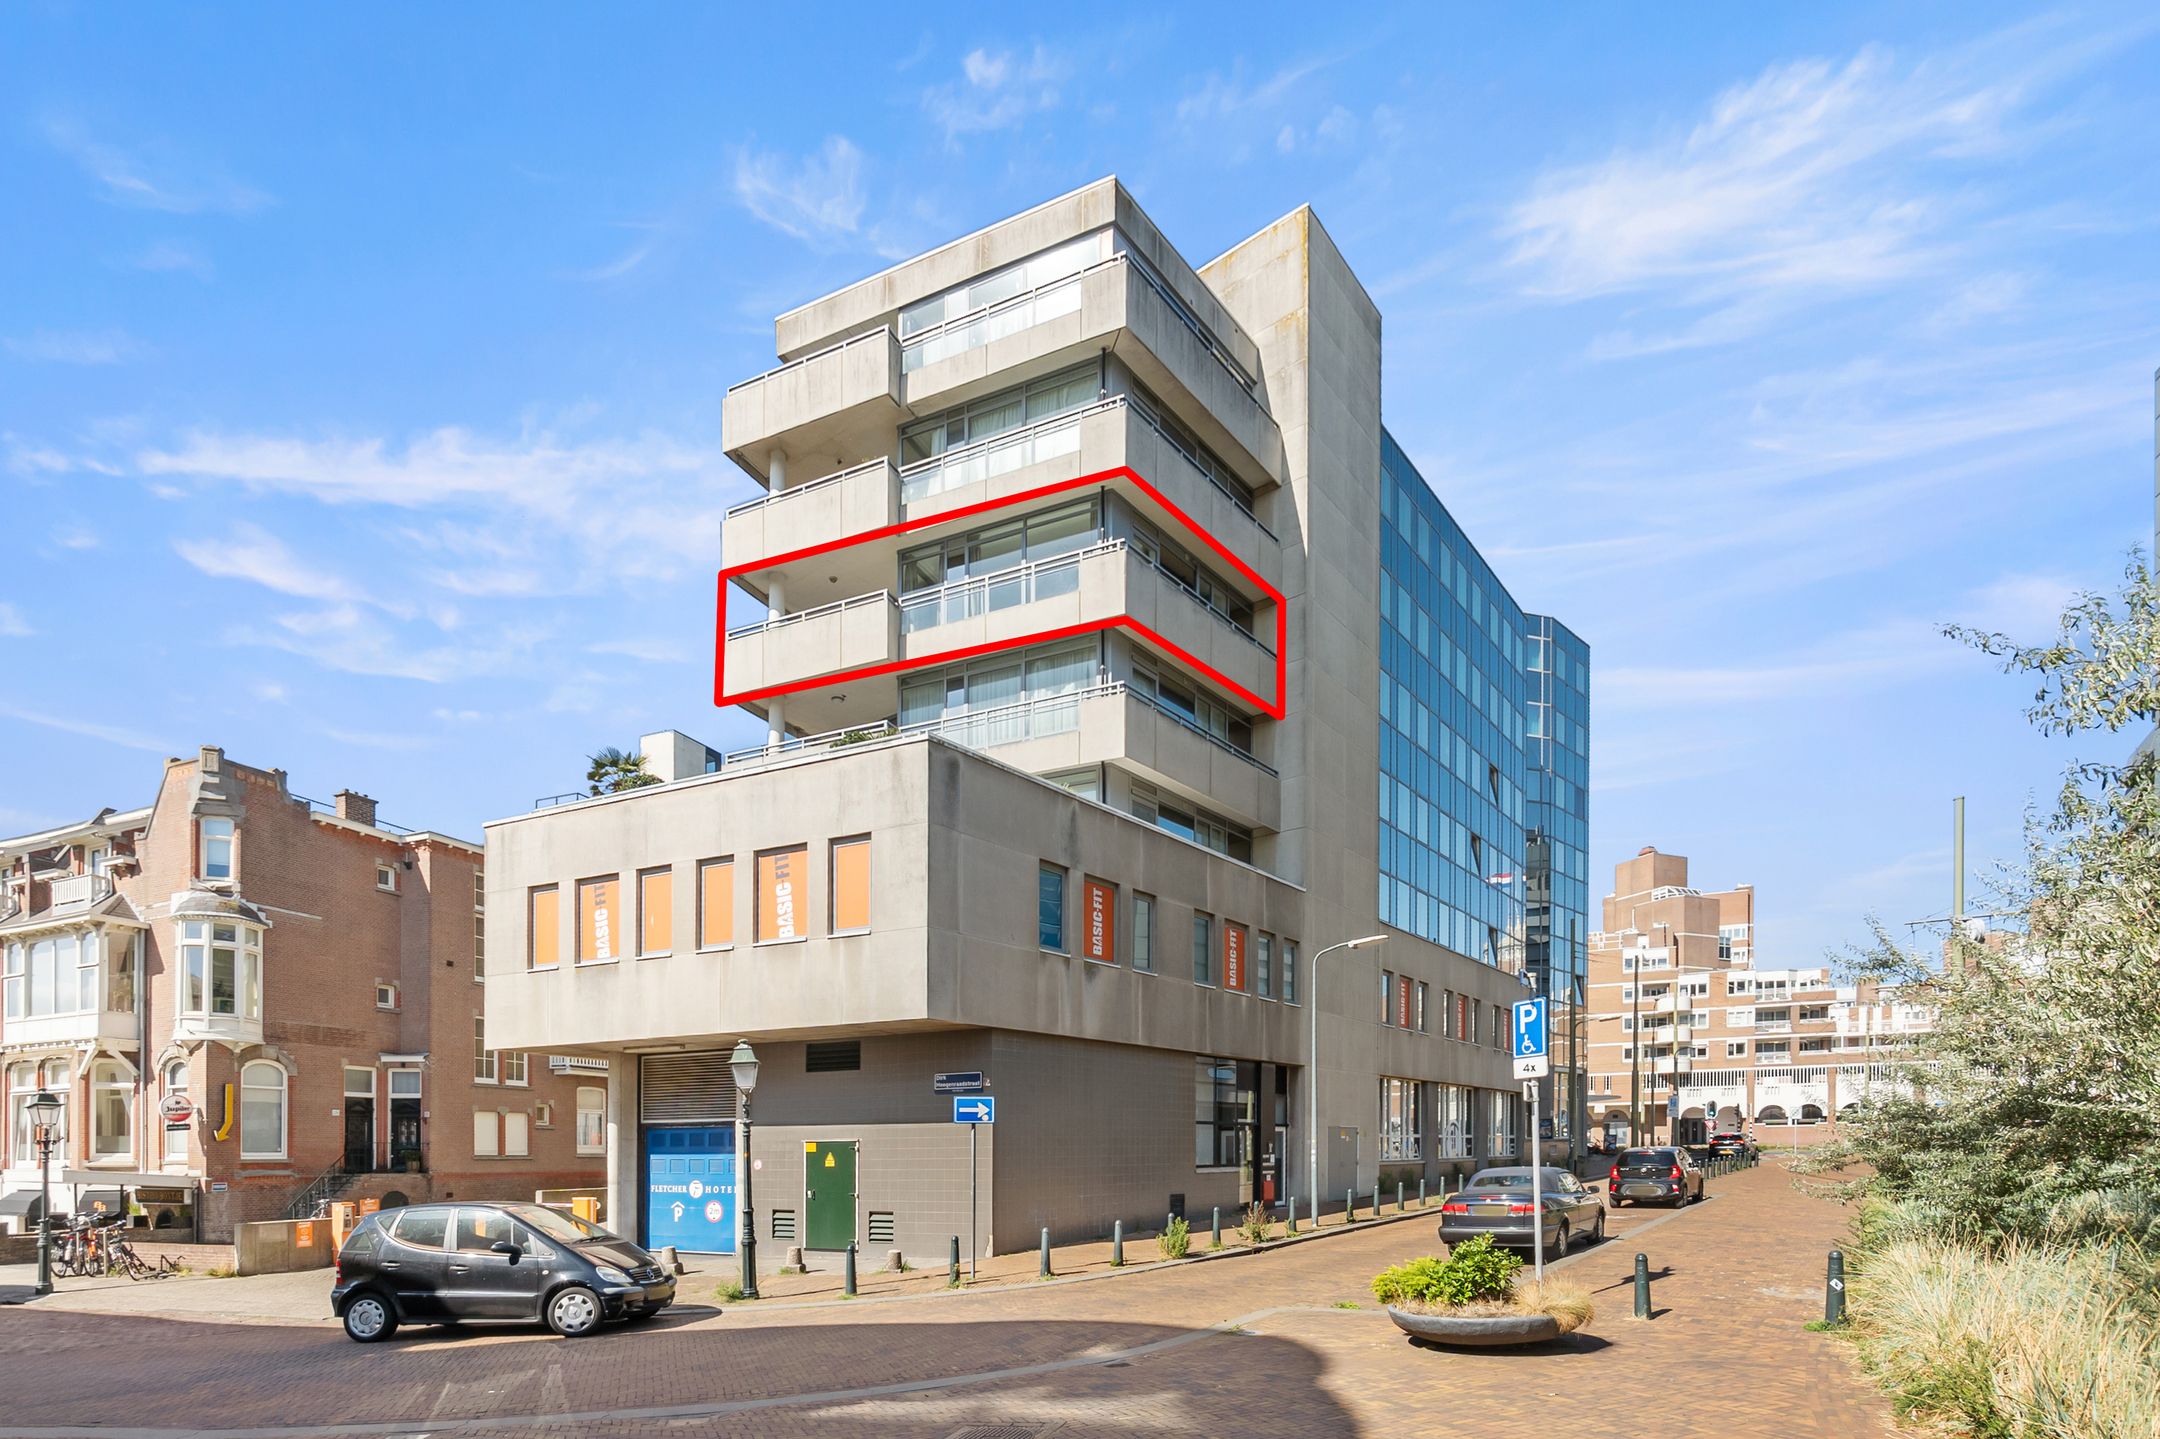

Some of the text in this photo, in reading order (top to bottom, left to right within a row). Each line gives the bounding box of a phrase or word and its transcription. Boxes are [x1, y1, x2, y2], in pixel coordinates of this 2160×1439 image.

[774, 855, 794, 938] BASIC-FIT
[594, 885, 610, 959] BASIC-FIT
[1093, 887, 1103, 956] BASIC-FIT
[1520, 1004, 1537, 1034] P
[1523, 1064, 1536, 1072] 4x
[650, 1185, 688, 1193] FLETCHER
[674, 1207, 683, 1222] P
